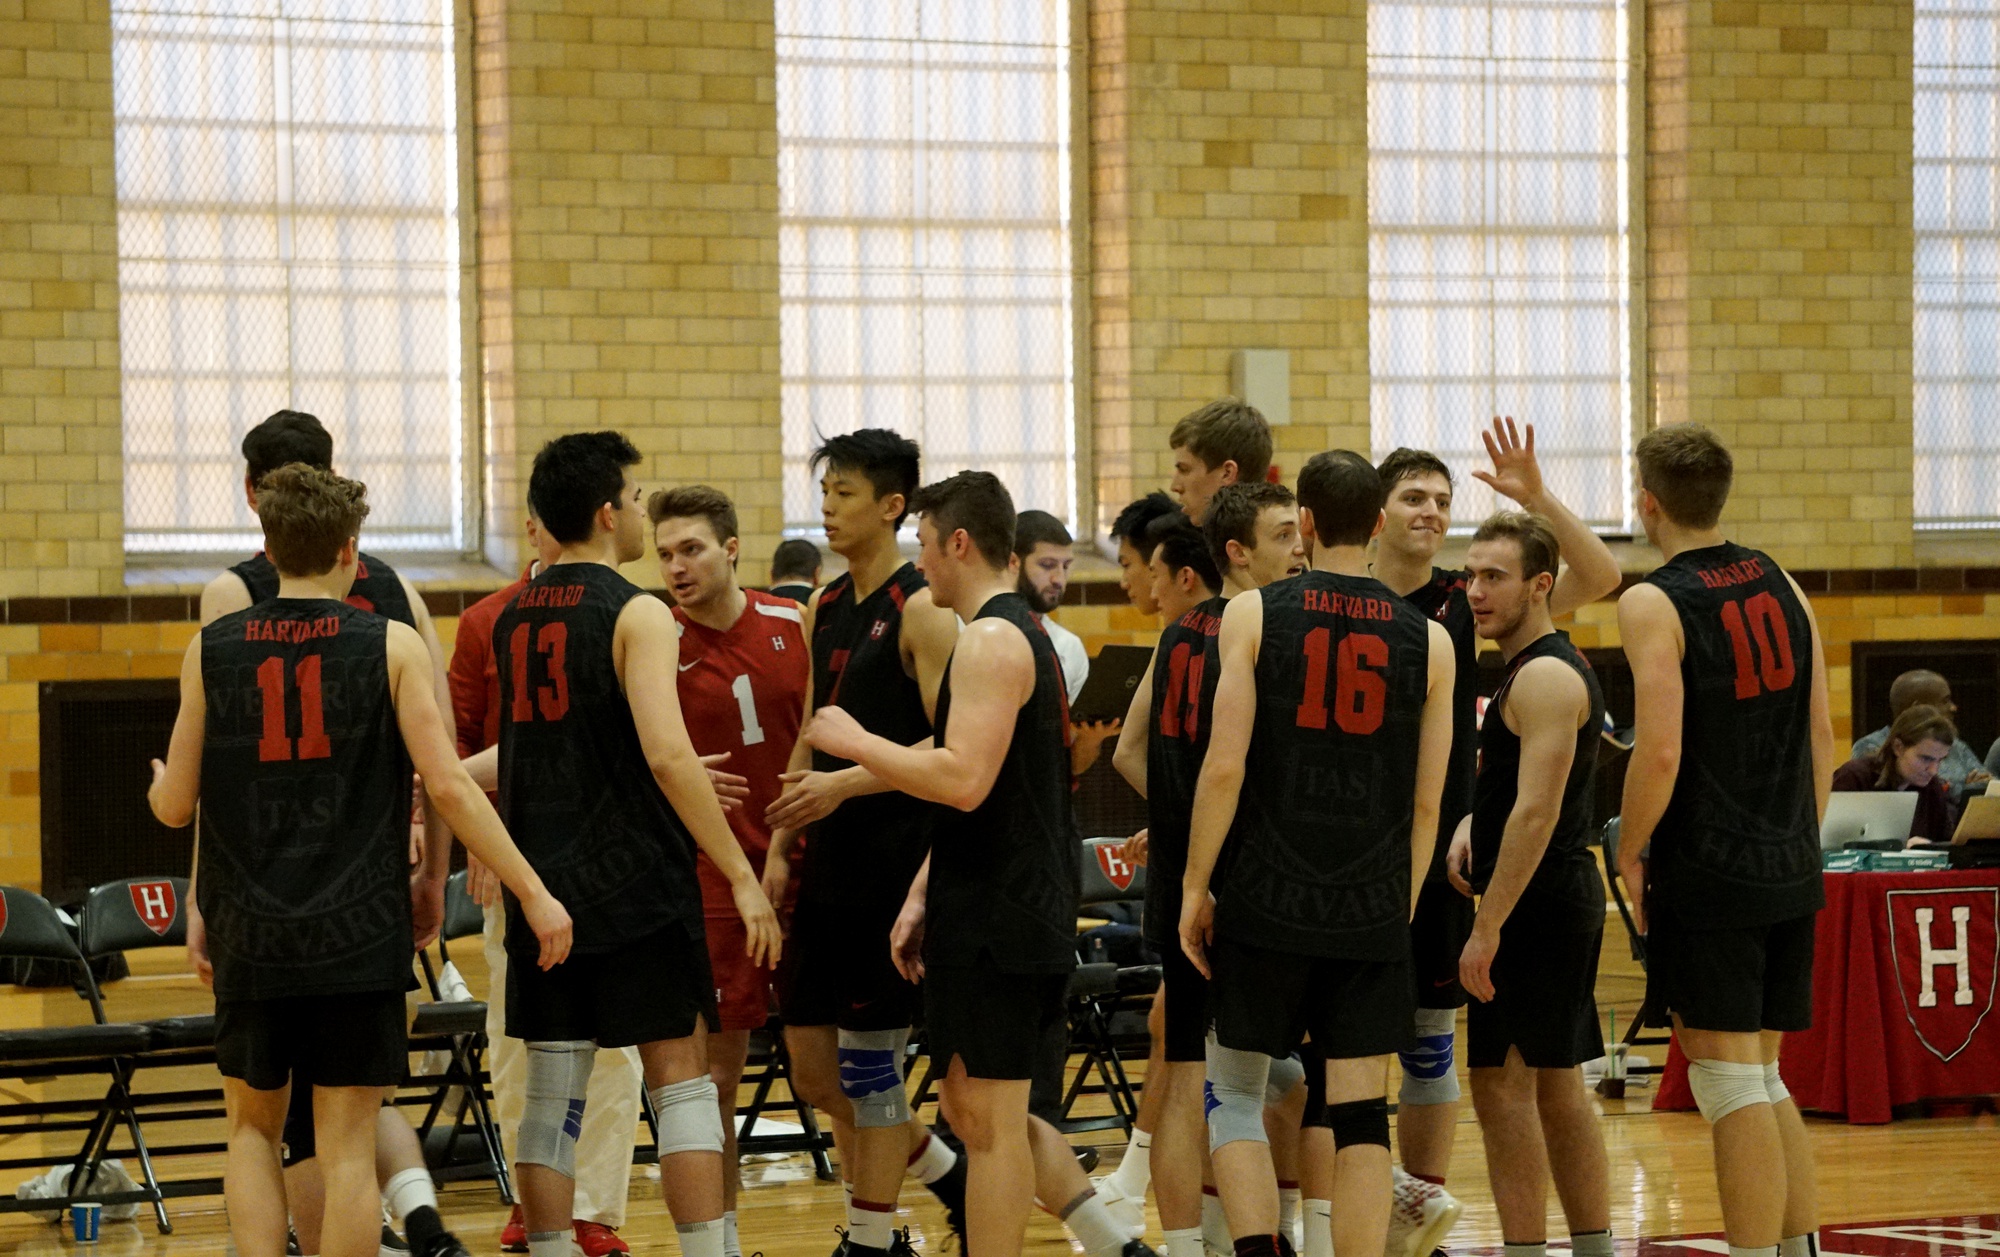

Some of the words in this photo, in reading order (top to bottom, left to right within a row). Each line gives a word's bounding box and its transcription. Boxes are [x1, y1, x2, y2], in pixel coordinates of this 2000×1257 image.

[517, 584, 585, 609] HARVARD
[1303, 588, 1393, 622] HARVARD
[244, 606, 340, 644] HARVARD
[771, 635, 786, 651] H
[871, 621, 886, 636] H
[1720, 590, 1796, 701] 10
[509, 621, 570, 722] 13
[1296, 626, 1390, 736] 16
[256, 653, 332, 762] 11
[731, 674, 765, 746] 1
[1104, 847, 1130, 877] H
[140, 886, 169, 920] H
[1914, 905, 1974, 1008] H
